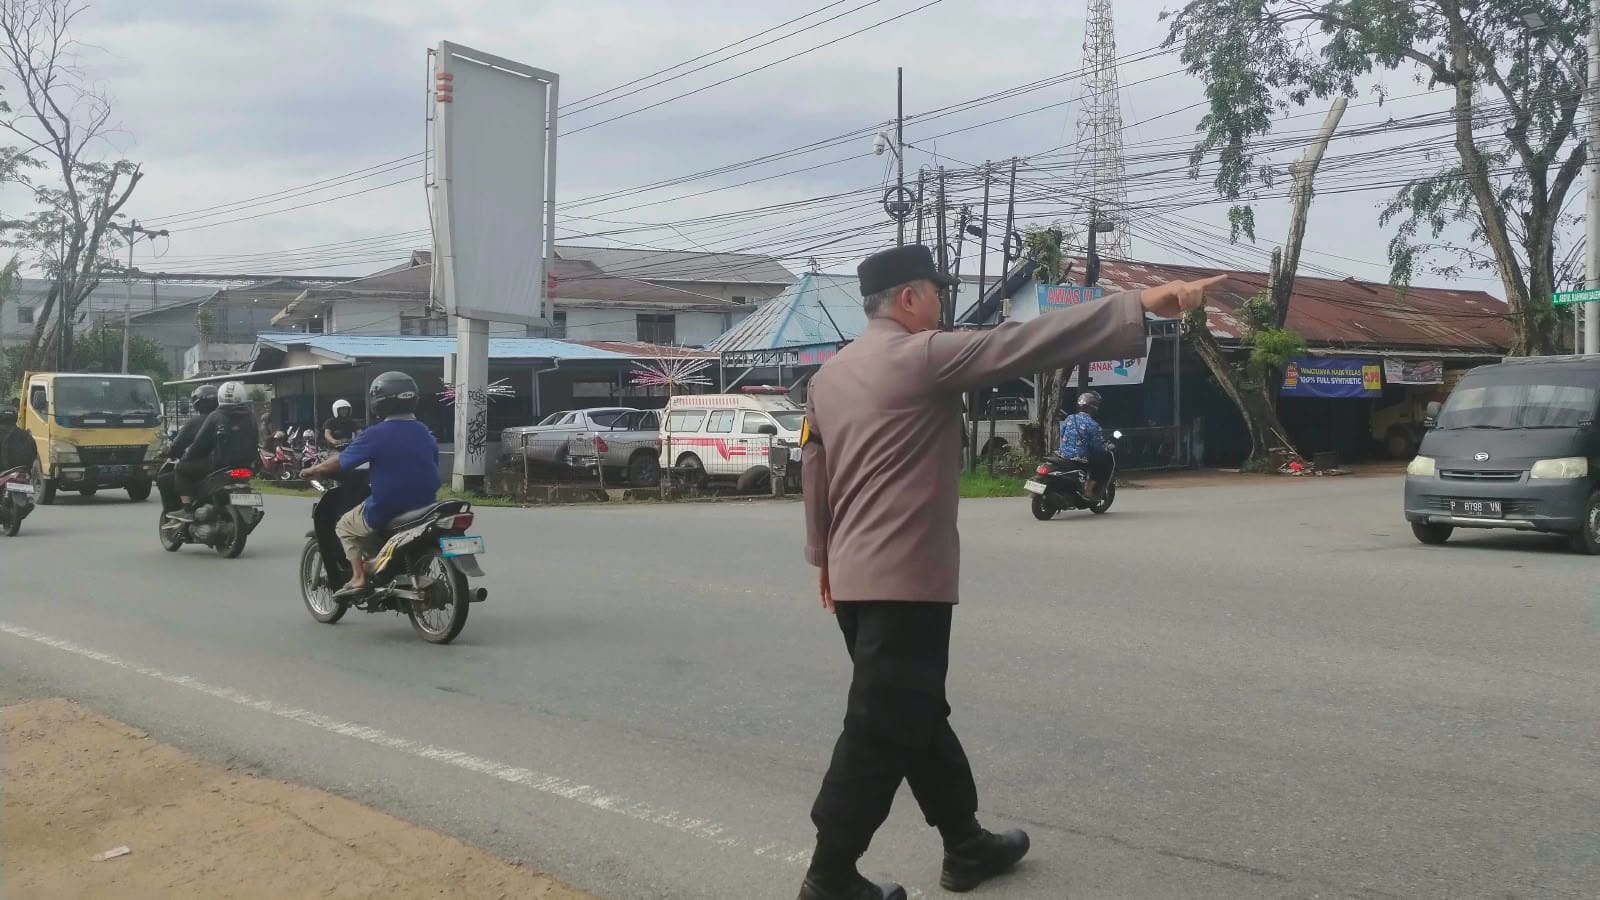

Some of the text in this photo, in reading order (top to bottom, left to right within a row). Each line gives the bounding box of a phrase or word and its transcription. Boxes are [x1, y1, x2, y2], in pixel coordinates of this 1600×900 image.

[1047, 287, 1080, 304] AWAS
[1316, 377, 1330, 385] FULL
[1331, 377, 1362, 385] SYNTHETIC
[1490, 501, 1501, 512] VN
